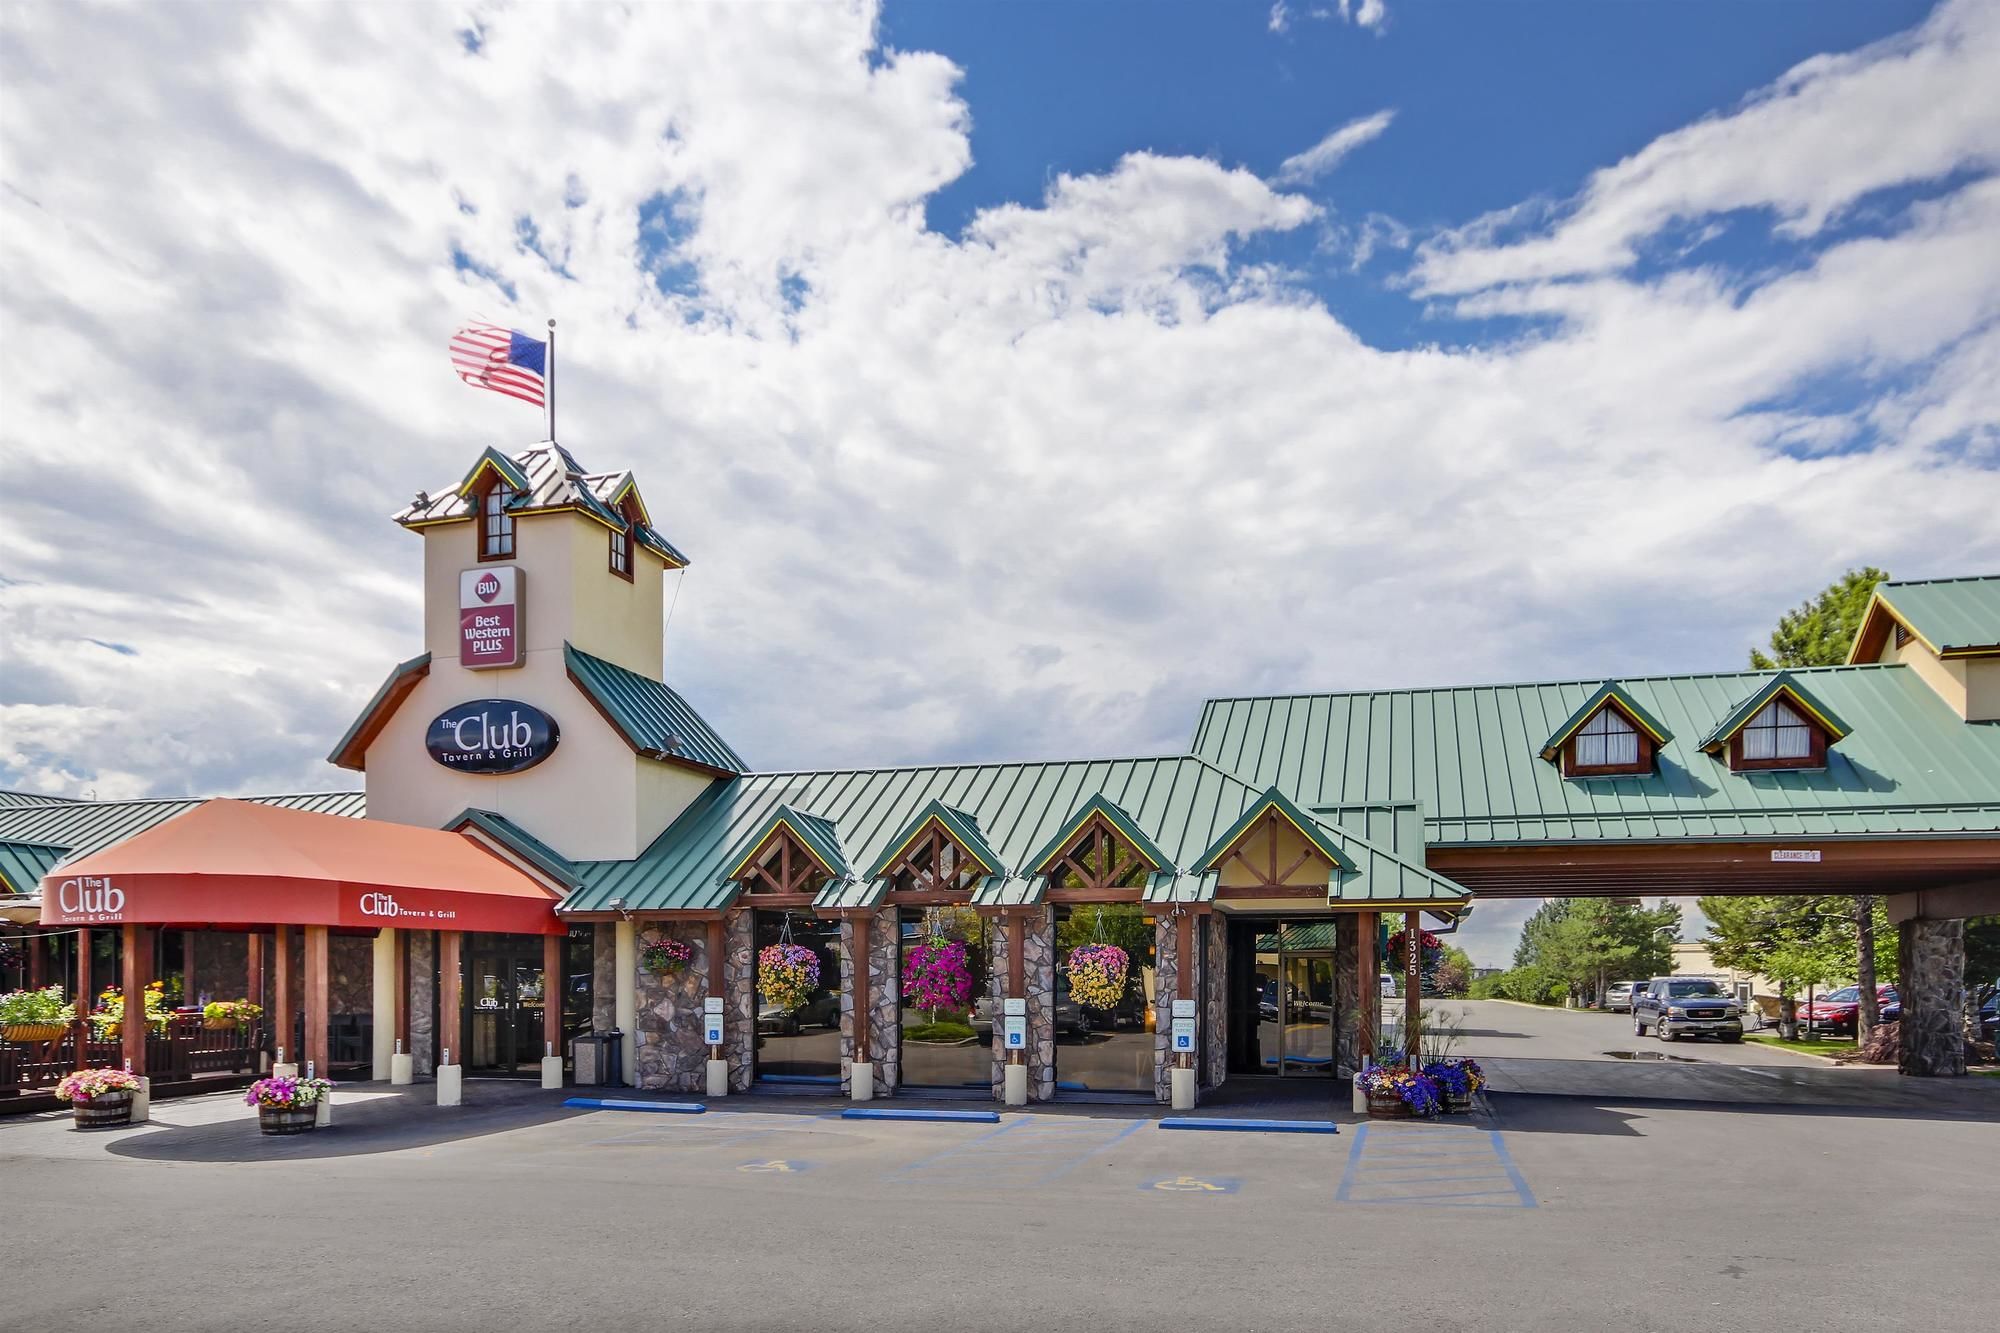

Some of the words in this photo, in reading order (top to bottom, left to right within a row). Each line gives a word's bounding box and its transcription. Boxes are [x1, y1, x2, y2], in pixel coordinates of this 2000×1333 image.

[478, 581, 497, 594] BW
[475, 616, 500, 627] Best
[464, 627, 510, 640] Western
[473, 639, 502, 652] PLUS
[441, 719, 457, 729] The
[454, 711, 532, 751] Club
[442, 752, 482, 762] Tavern
[489, 750, 496, 759] &
[503, 747, 532, 758] Grill
[84, 877, 102, 888] The
[59, 877, 125, 913] Club
[360, 892, 398, 917] Club
[61, 914, 85, 922] Tavern
[98, 913, 122, 921] Grill
[399, 908, 426, 917] Tavern
[1409, 928, 1417, 976] 1325
[480, 997, 498, 1007] Club
